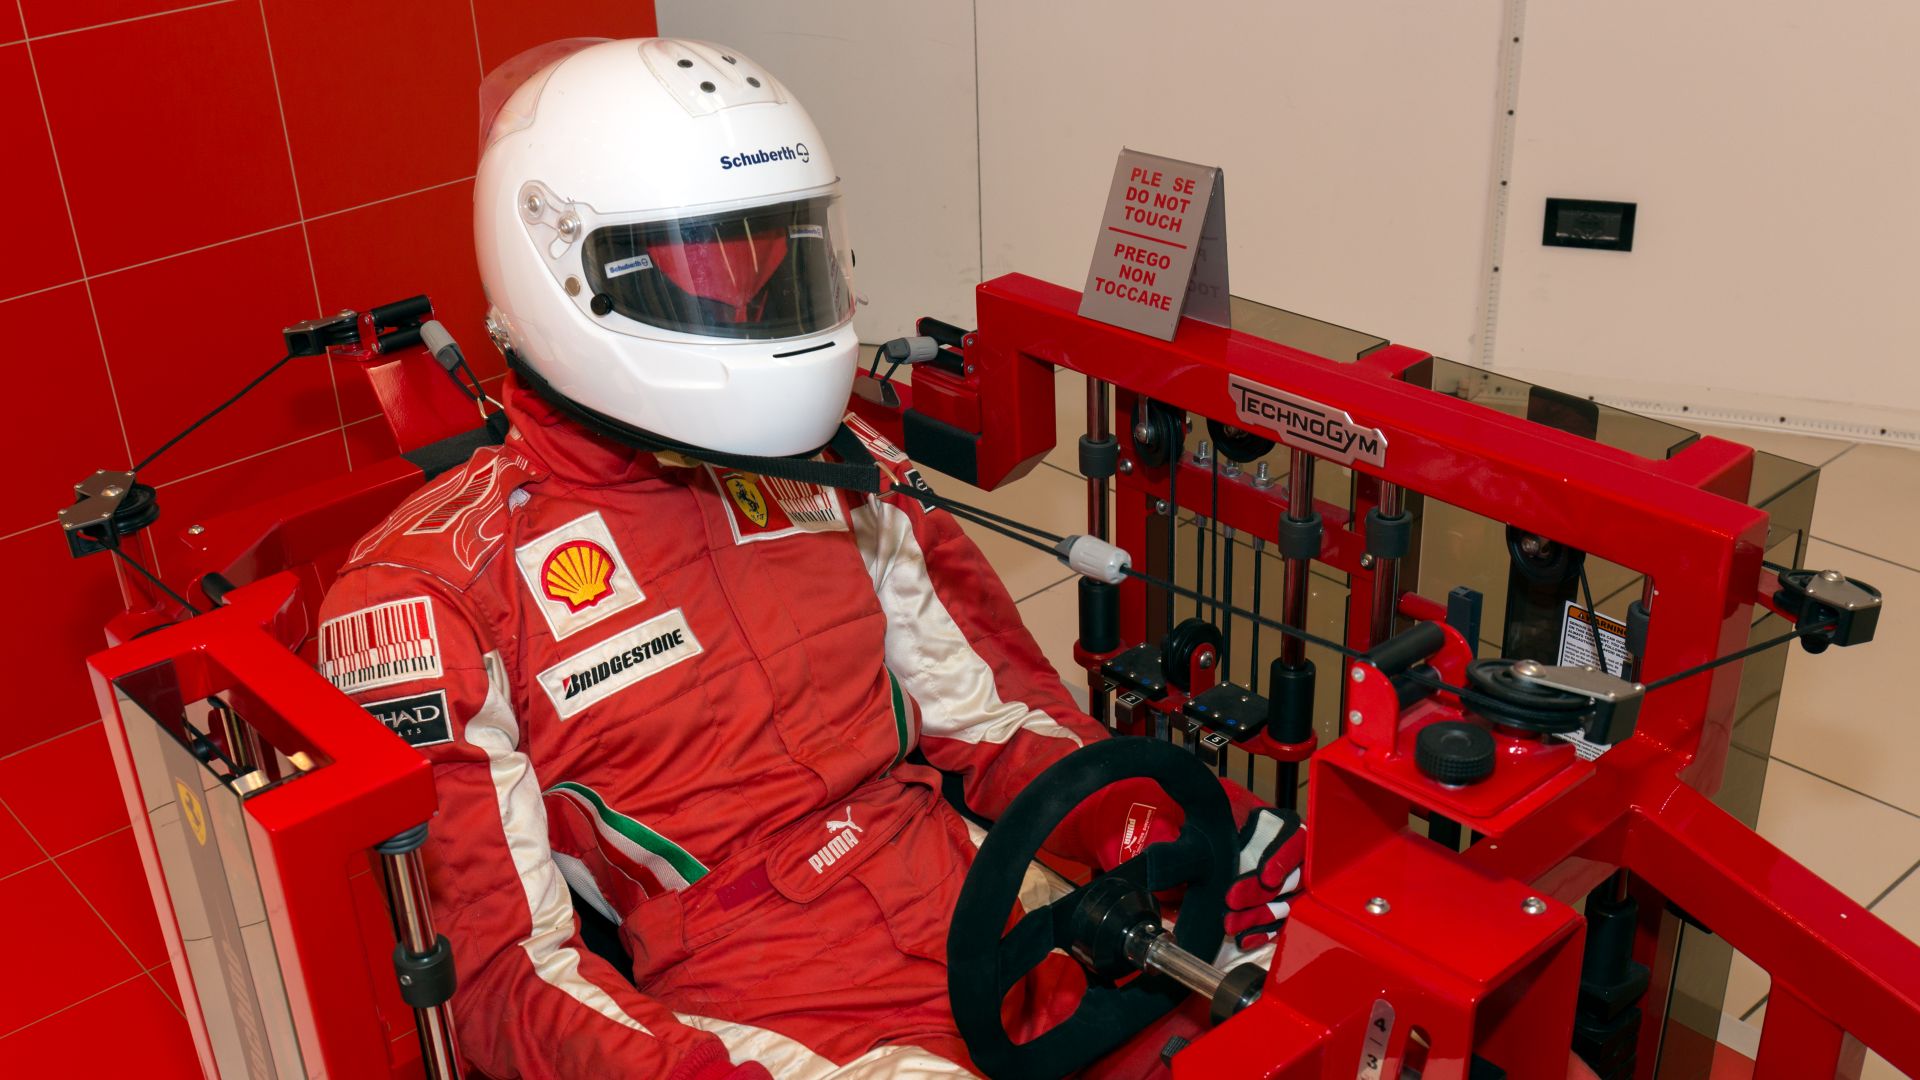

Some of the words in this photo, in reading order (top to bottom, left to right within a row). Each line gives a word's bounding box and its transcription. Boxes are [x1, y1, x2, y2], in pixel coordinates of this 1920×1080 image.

[720, 145, 796, 170] Schuberth
[1126, 186, 1149, 204] DO
[1153, 192, 1191, 214] NOT
[1124, 205, 1183, 233] TOUCH
[1113, 243, 1171, 270] PREGO
[1118, 263, 1156, 287] NON
[1095, 277, 1173, 312] TOCCARE
[562, 628, 684, 700] BRIDGESTONE
[373, 705, 440, 728] HAD
[808, 828, 859, 874] PUMA
[1373, 1018, 1386, 1032] 4
[1366, 1053, 1378, 1070] 3
